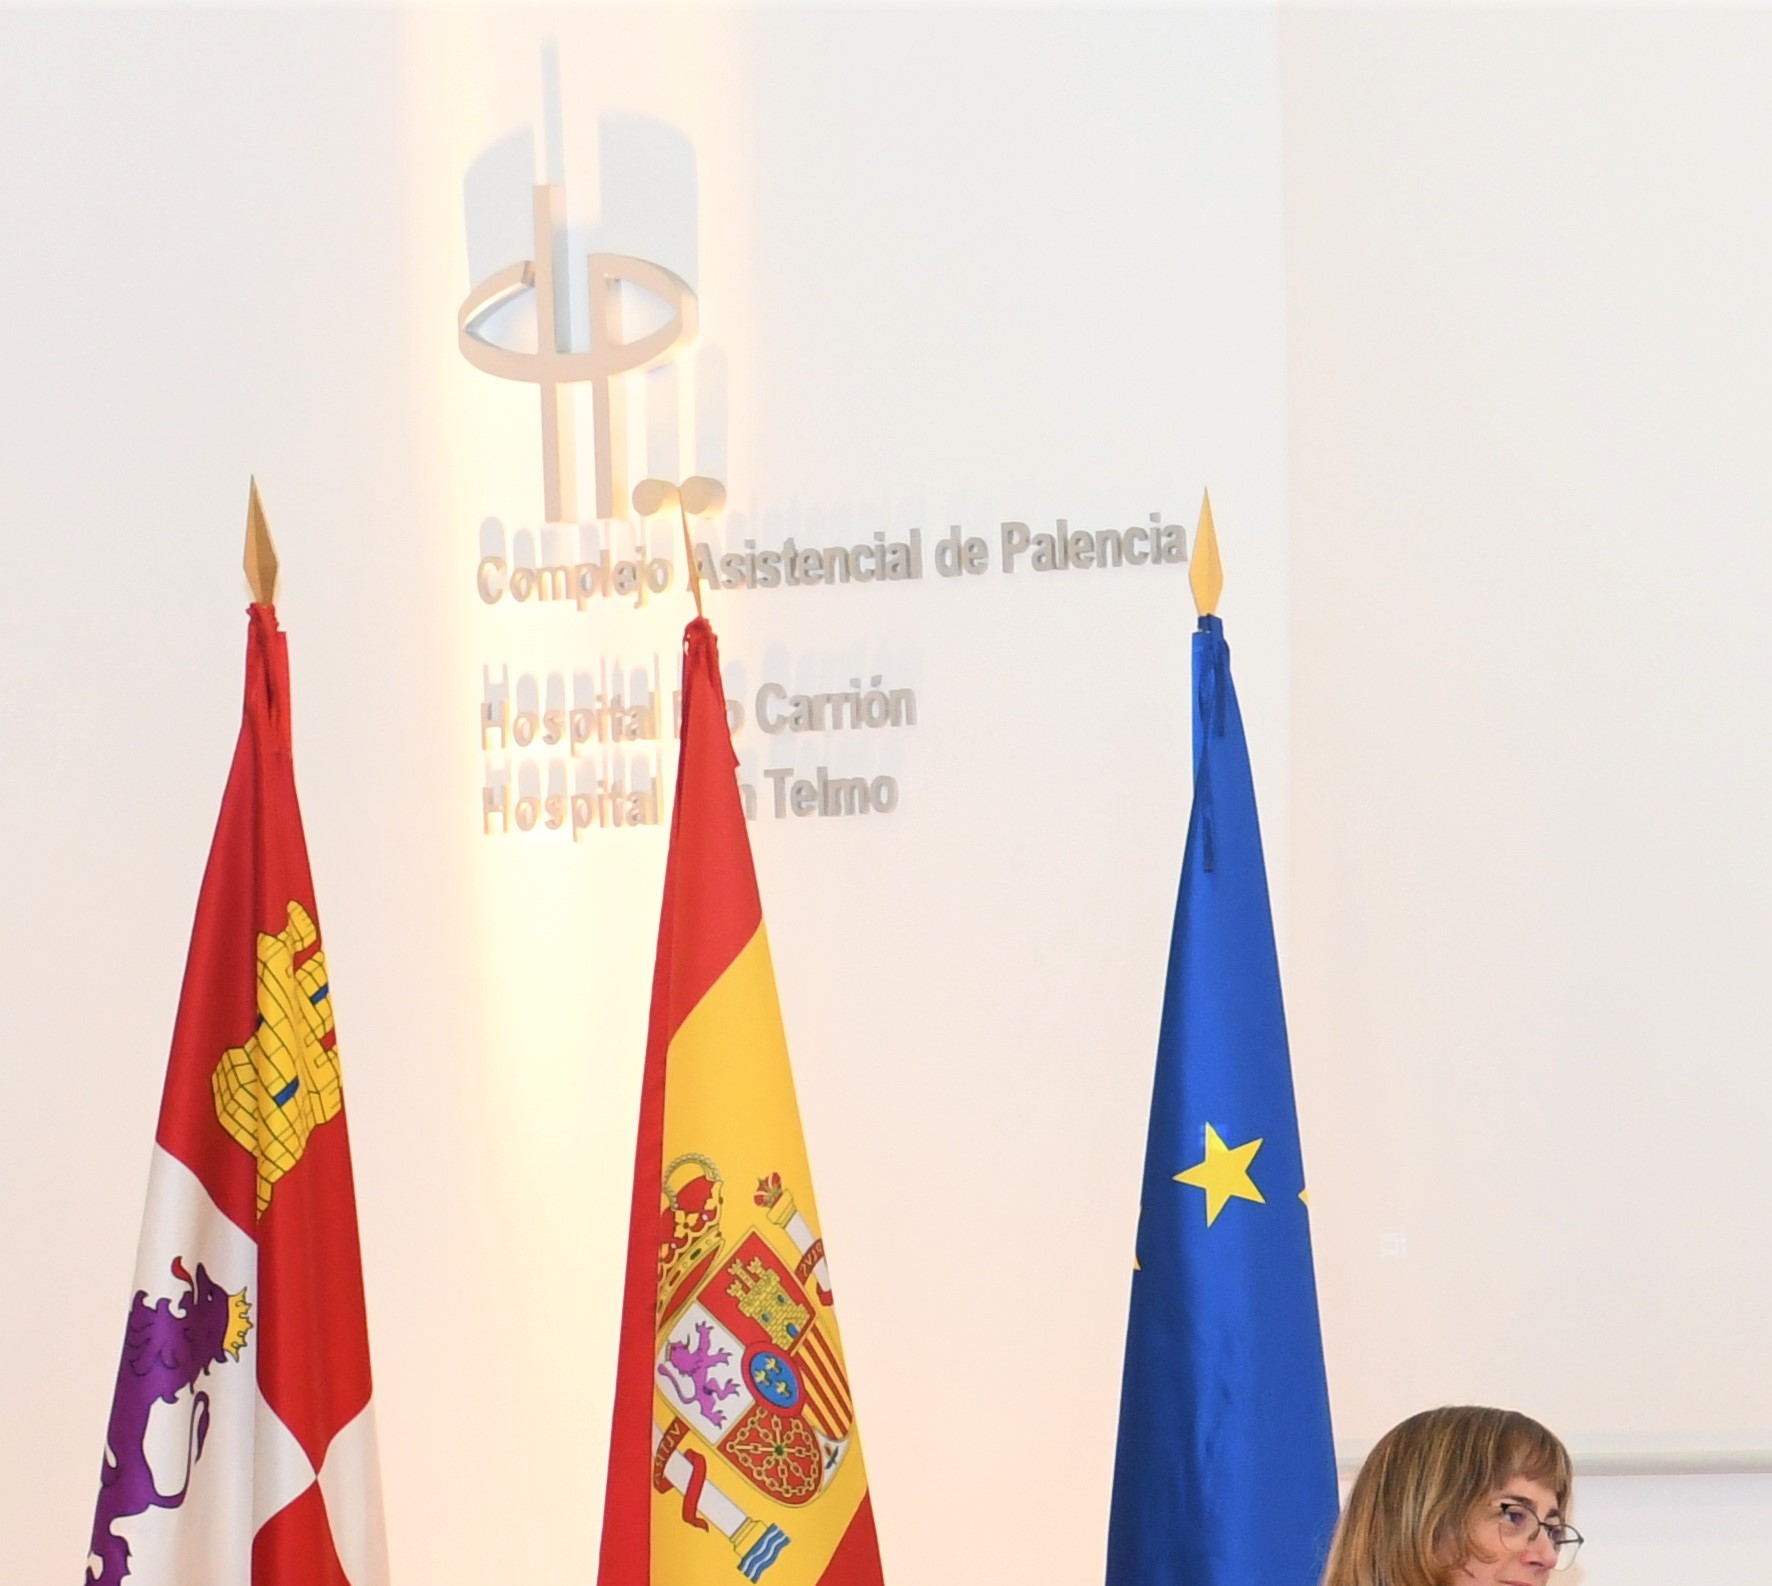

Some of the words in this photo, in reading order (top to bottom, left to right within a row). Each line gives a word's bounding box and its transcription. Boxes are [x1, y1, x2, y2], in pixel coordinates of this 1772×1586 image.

[476, 545, 673, 613] Complejo
[686, 527, 922, 592] Asistencial
[935, 524, 989, 578] de
[1001, 511, 1188, 574] Palencia
[481, 692, 660, 757] Hospital
[755, 674, 918, 735] Carrión
[483, 777, 660, 842] Hospital
[763, 765, 899, 819] Telmo
